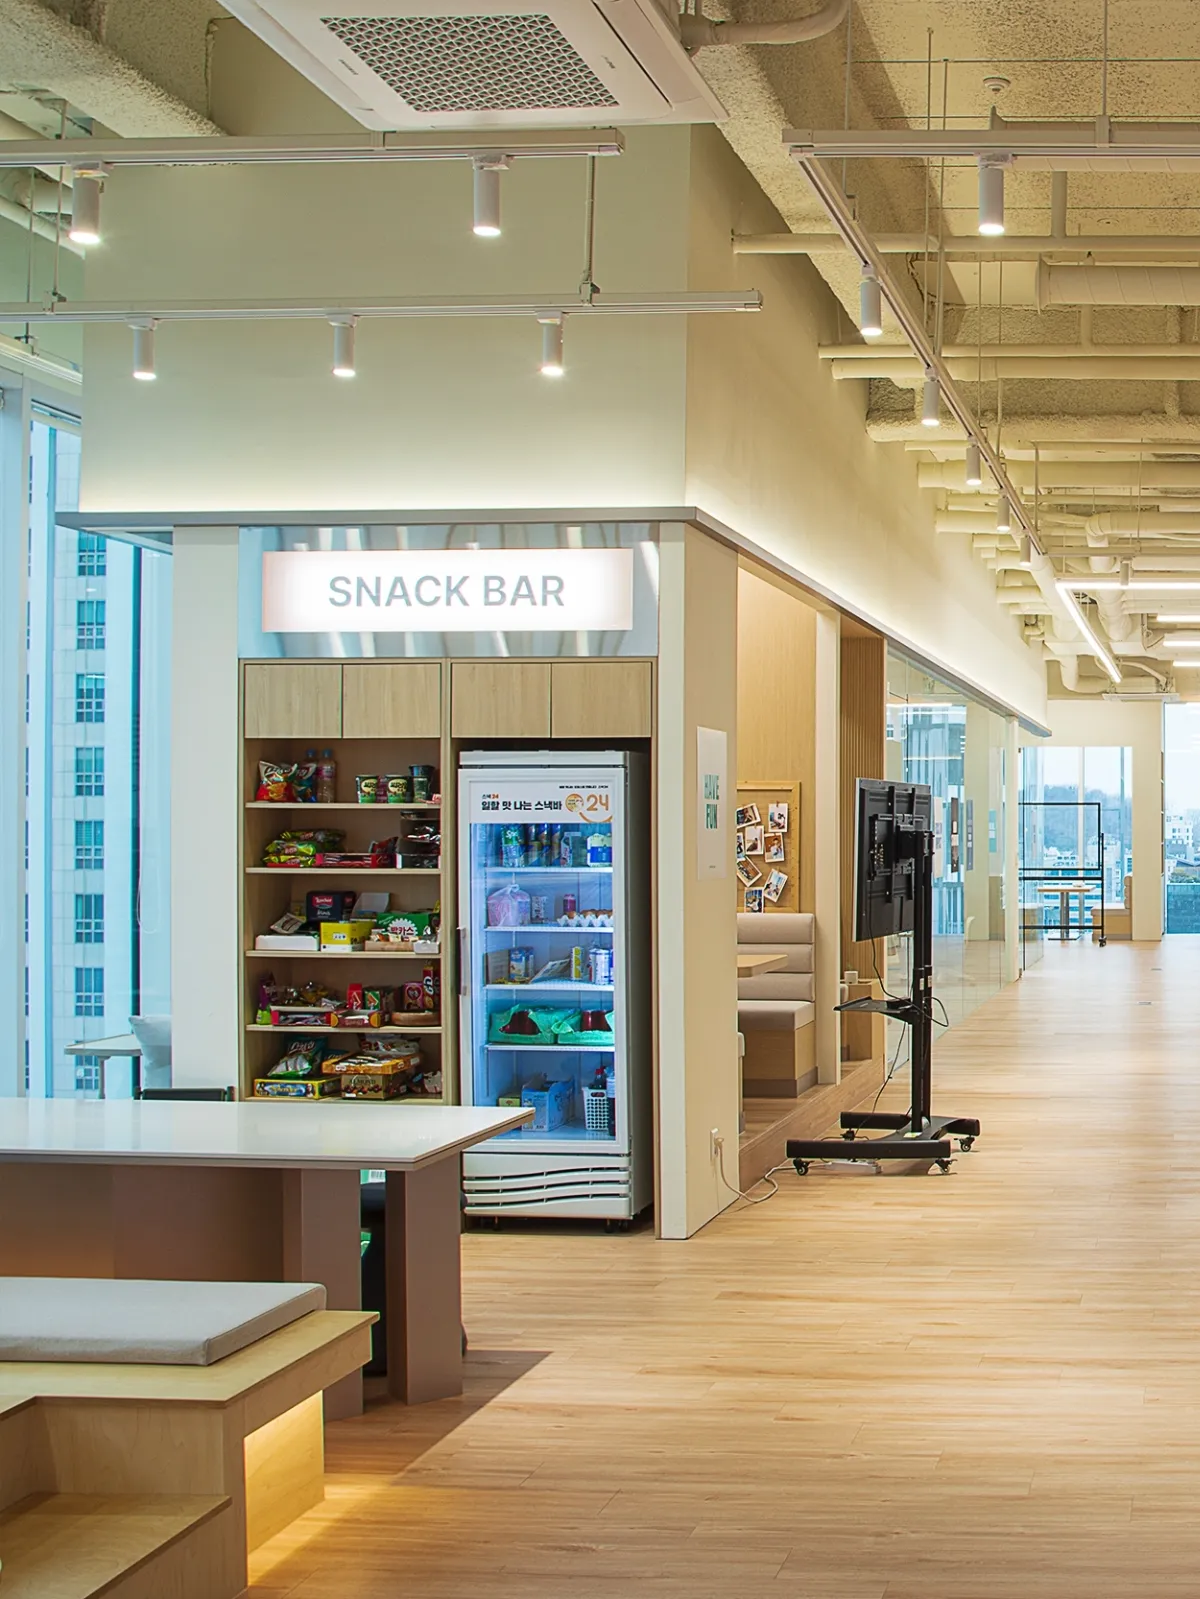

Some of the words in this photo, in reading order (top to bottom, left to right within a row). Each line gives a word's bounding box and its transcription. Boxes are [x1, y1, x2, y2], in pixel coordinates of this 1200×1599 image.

[328, 575, 470, 607] SNACK
[483, 575, 565, 607] BAR
[704, 774, 719, 800] HAVE
[481, 800, 500, 811] 일할
[502, 800, 512, 811] 맛
[514, 800, 532, 811] 나는
[534, 800, 562, 811] 스낵바
[586, 793, 609, 811] 24
[705, 803, 718, 829] FUN
[391, 926, 414, 936] 박카스
